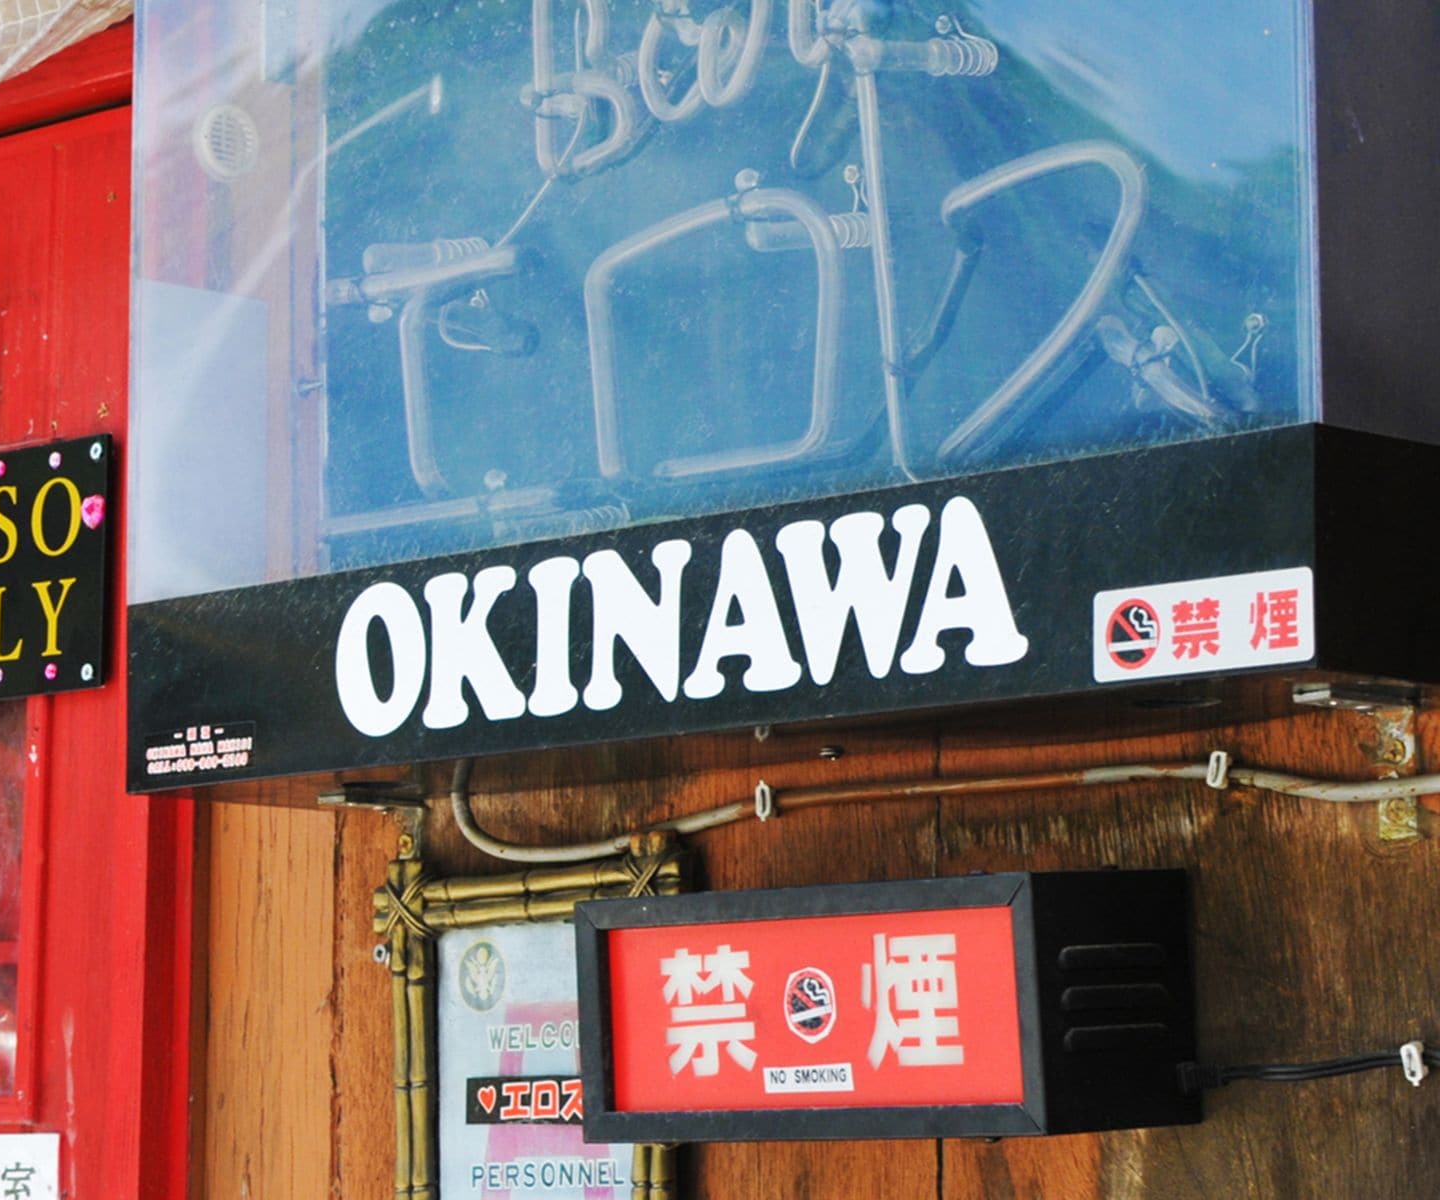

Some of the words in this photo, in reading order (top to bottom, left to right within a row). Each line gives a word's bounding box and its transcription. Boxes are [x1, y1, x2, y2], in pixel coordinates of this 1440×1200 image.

[335, 496, 1028, 737] OKINAWA
[659, 933, 965, 1078] 禁煙
[488, 1023, 579, 1050] WELCO
[770, 1069, 787, 1084] NO
[794, 1067, 847, 1084] SMOKING
[471, 1160, 625, 1189] PERSONNEL
